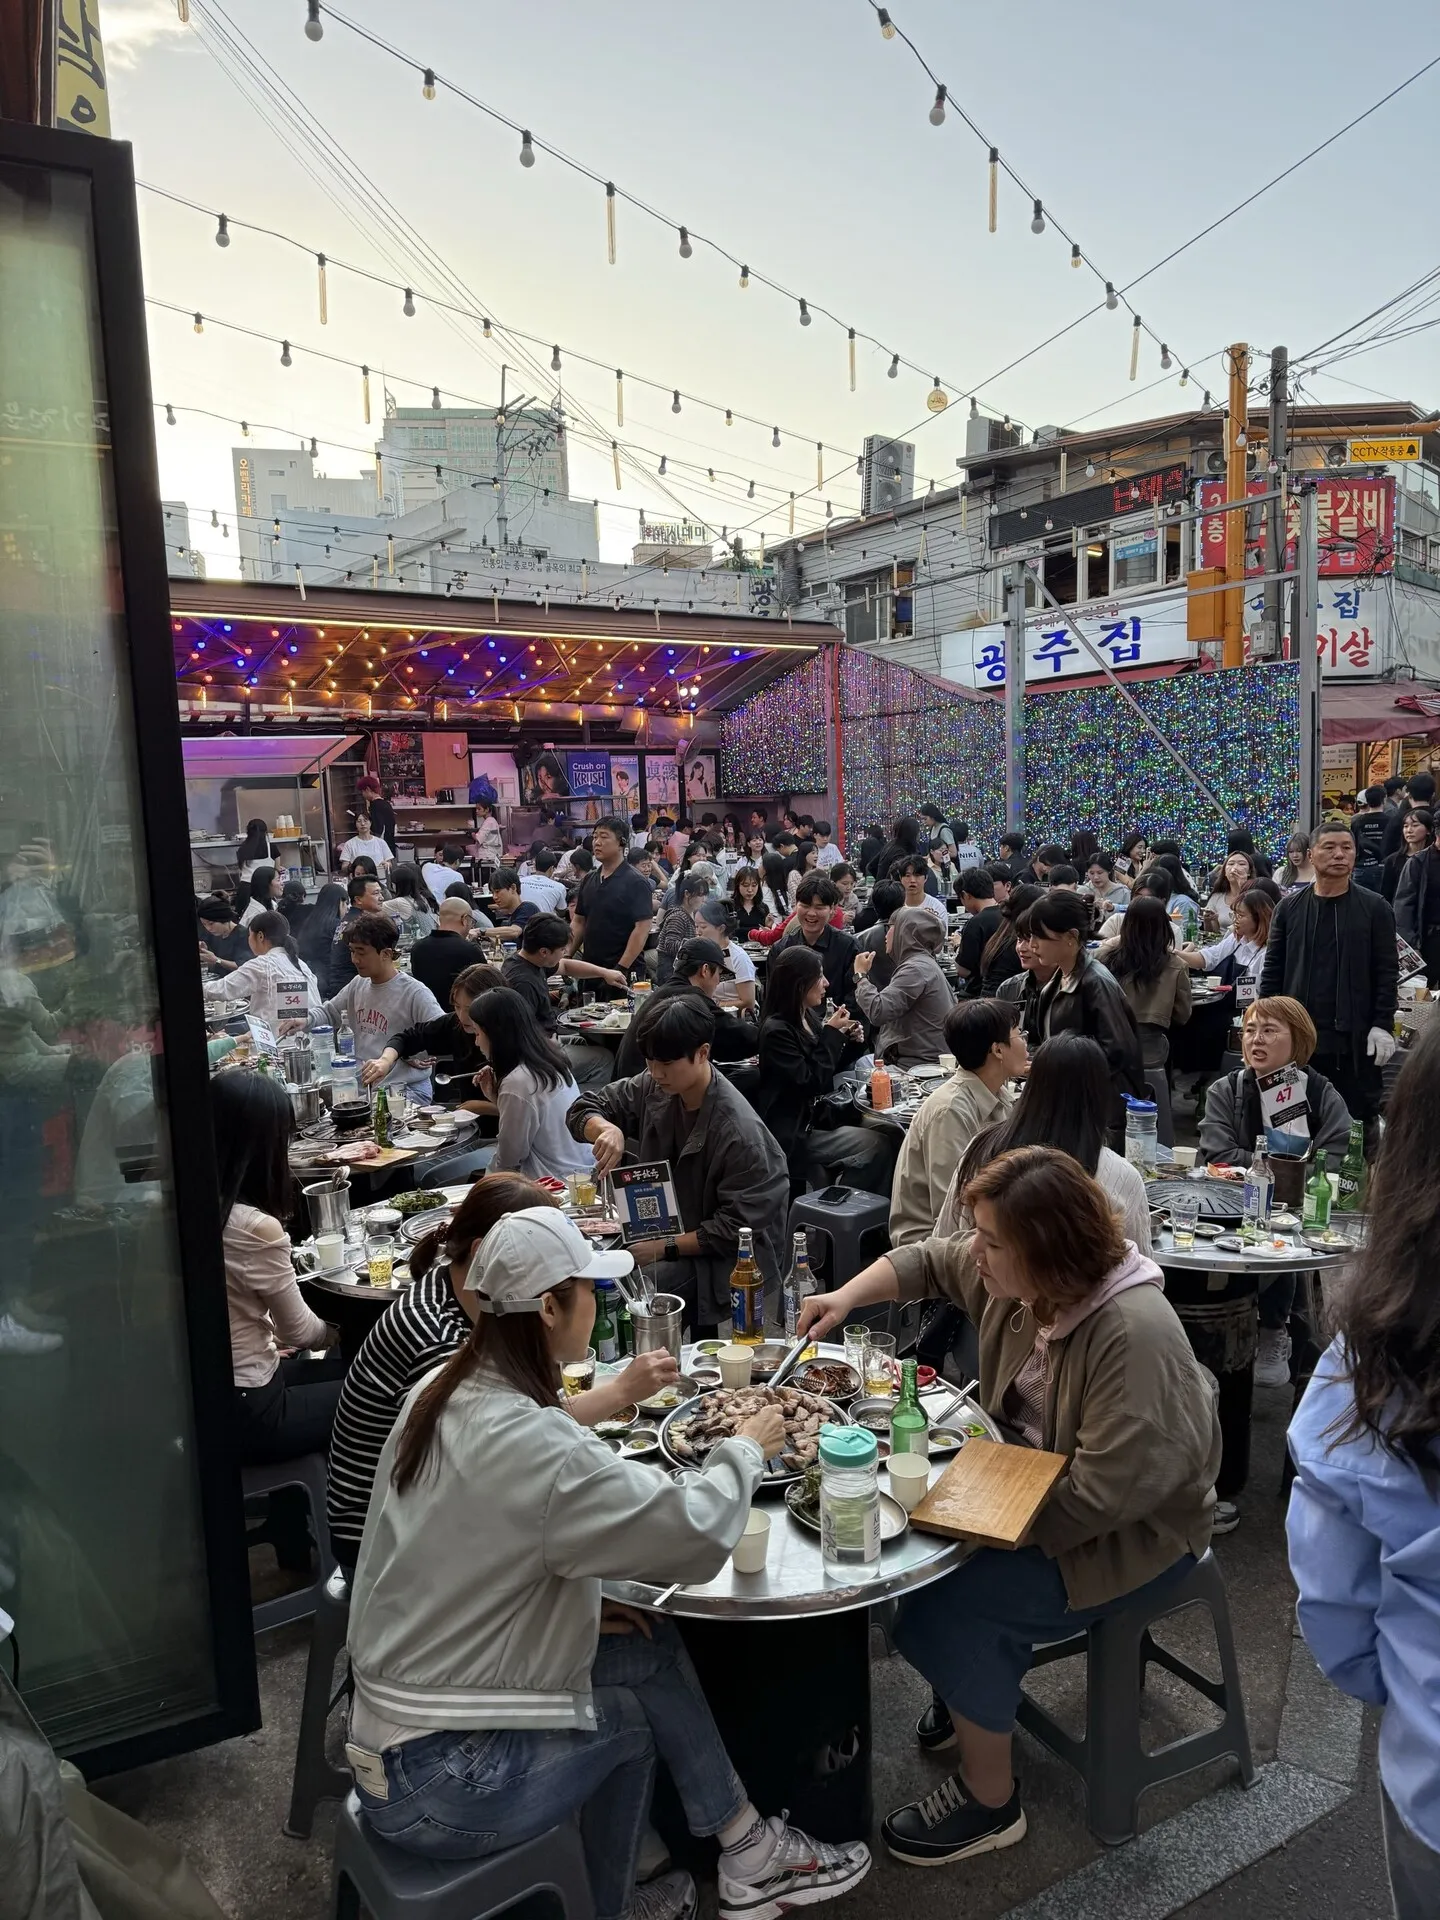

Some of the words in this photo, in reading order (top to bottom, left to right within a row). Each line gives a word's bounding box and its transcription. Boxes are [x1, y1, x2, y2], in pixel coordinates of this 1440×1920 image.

[1352, 446, 1379, 457] CCTV
[1259, 487, 1386, 546] 숯불갈비
[572, 762, 594, 770] Crush
[595, 762, 606, 770] on
[573, 770, 607, 789] KRUSH
[959, 851, 977, 859] NIKE
[1241, 988, 1252, 996] 50
[285, 995, 301, 1005] 34
[1275, 1086, 1292, 1104] 47
[1338, 1177, 1359, 1192] ERRA
